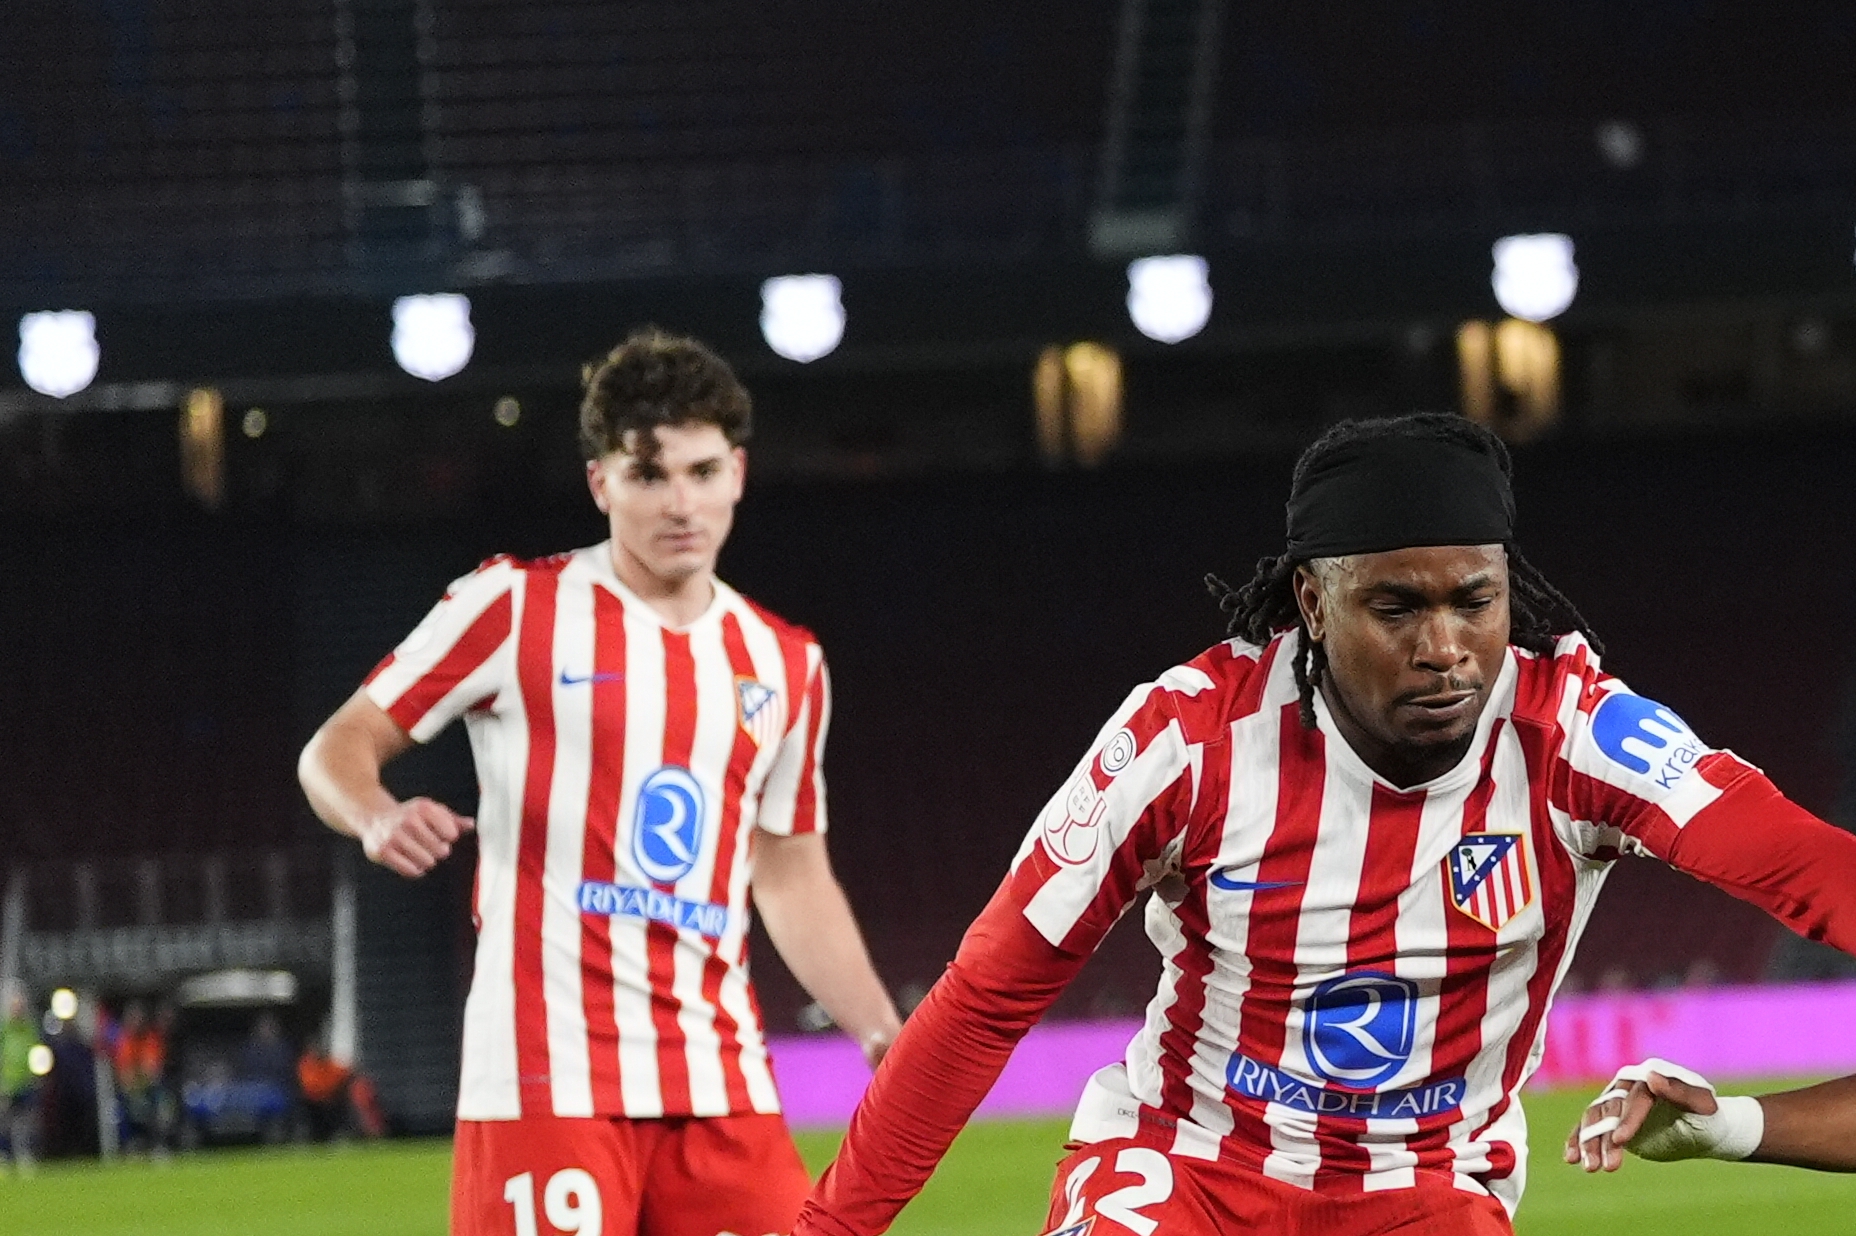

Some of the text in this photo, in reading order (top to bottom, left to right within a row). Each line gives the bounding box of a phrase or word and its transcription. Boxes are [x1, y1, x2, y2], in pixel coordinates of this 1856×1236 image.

[1654, 738, 1704, 789] krak
[581, 881, 727, 938] RIYADH AIR
[1232, 1055, 1458, 1116] RIYADH AIR
